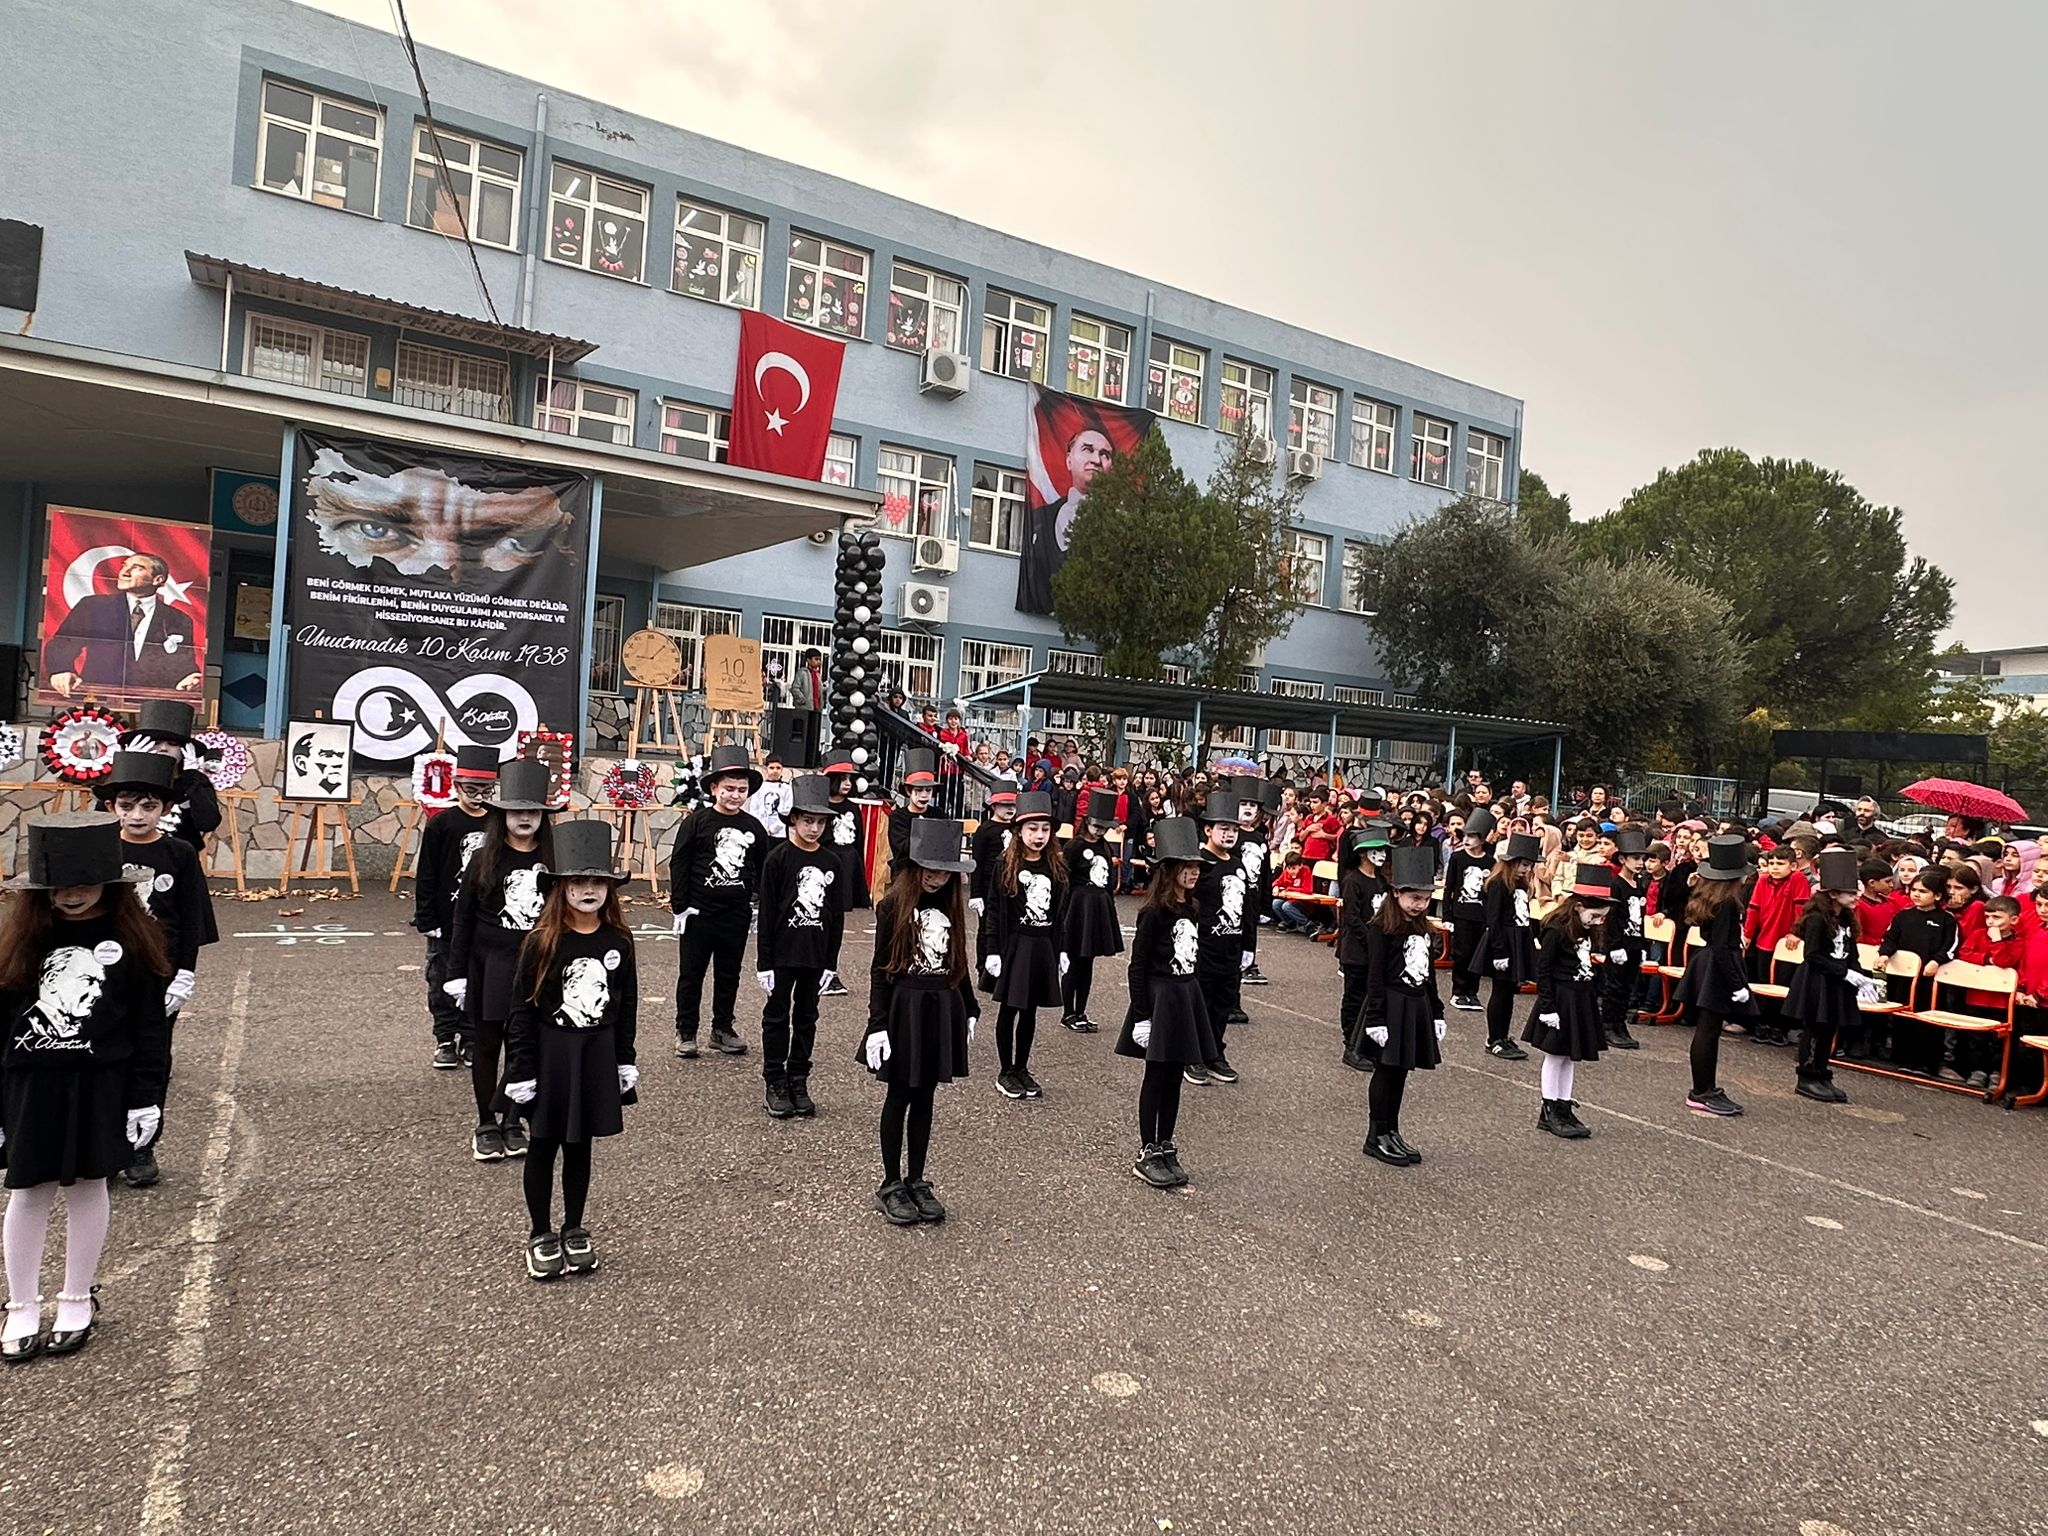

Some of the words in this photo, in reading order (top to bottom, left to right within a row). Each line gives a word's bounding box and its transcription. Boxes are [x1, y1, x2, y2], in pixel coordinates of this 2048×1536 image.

[306, 577, 330, 588] BENİ
[331, 580, 372, 593] GÖRMEK
[373, 584, 408, 597] DEMEK,
[409, 588, 452, 600] MUTLAKA
[453, 591, 491, 604] YÜZÜMÜ
[491, 596, 528, 608] GÖRMEK
[529, 600, 569, 612] DEĞİLDİR.
[310, 591, 341, 602] BENİM
[342, 594, 399, 609] FİKİRLERİMİ,
[400, 600, 430, 611] BENİM
[431, 603, 491, 616] DUYGULARIMI
[491, 609, 553, 623] ANLIYORSANIZ
[554, 614, 566, 624] VE
[375, 609, 455, 626] HİSSEDİYORSANIZ
[456, 618, 469, 627] BU
[296, 624, 409, 654] Unutmadık
[416, 636, 445, 656] 10
[445, 637, 512, 663] Kasım
[514, 643, 570, 667] 1938
[720, 657, 745, 678] 10
